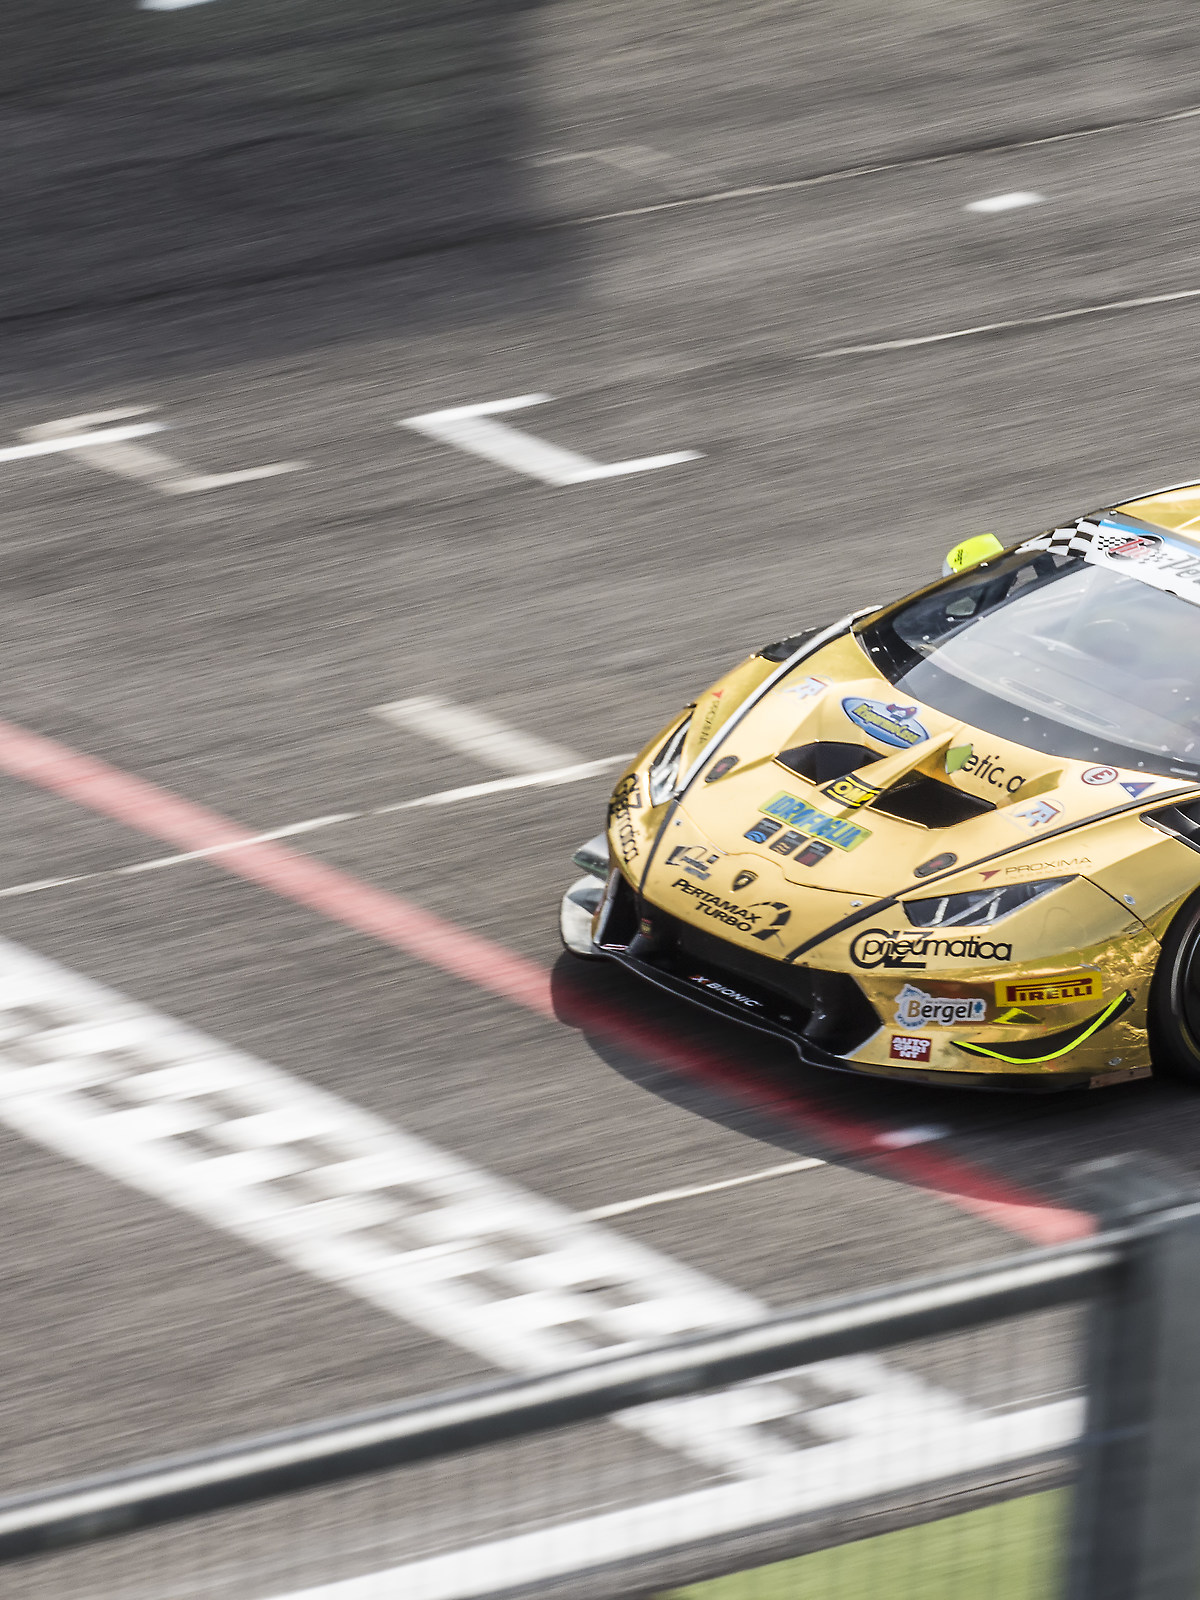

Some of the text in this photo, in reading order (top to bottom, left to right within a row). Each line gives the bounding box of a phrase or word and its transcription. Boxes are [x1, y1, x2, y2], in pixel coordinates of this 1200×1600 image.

[832, 781, 875, 804] OMP
[1005, 857, 1091, 875] PROXIMA
[671, 878, 763, 924] PERTAMAX
[695, 902, 752, 932] TURBO
[862, 936, 1012, 961] pneumatica
[1006, 978, 1093, 1002] PIRELLI
[907, 1000, 974, 1023] Bergel
[892, 1036, 931, 1047] AUTO
